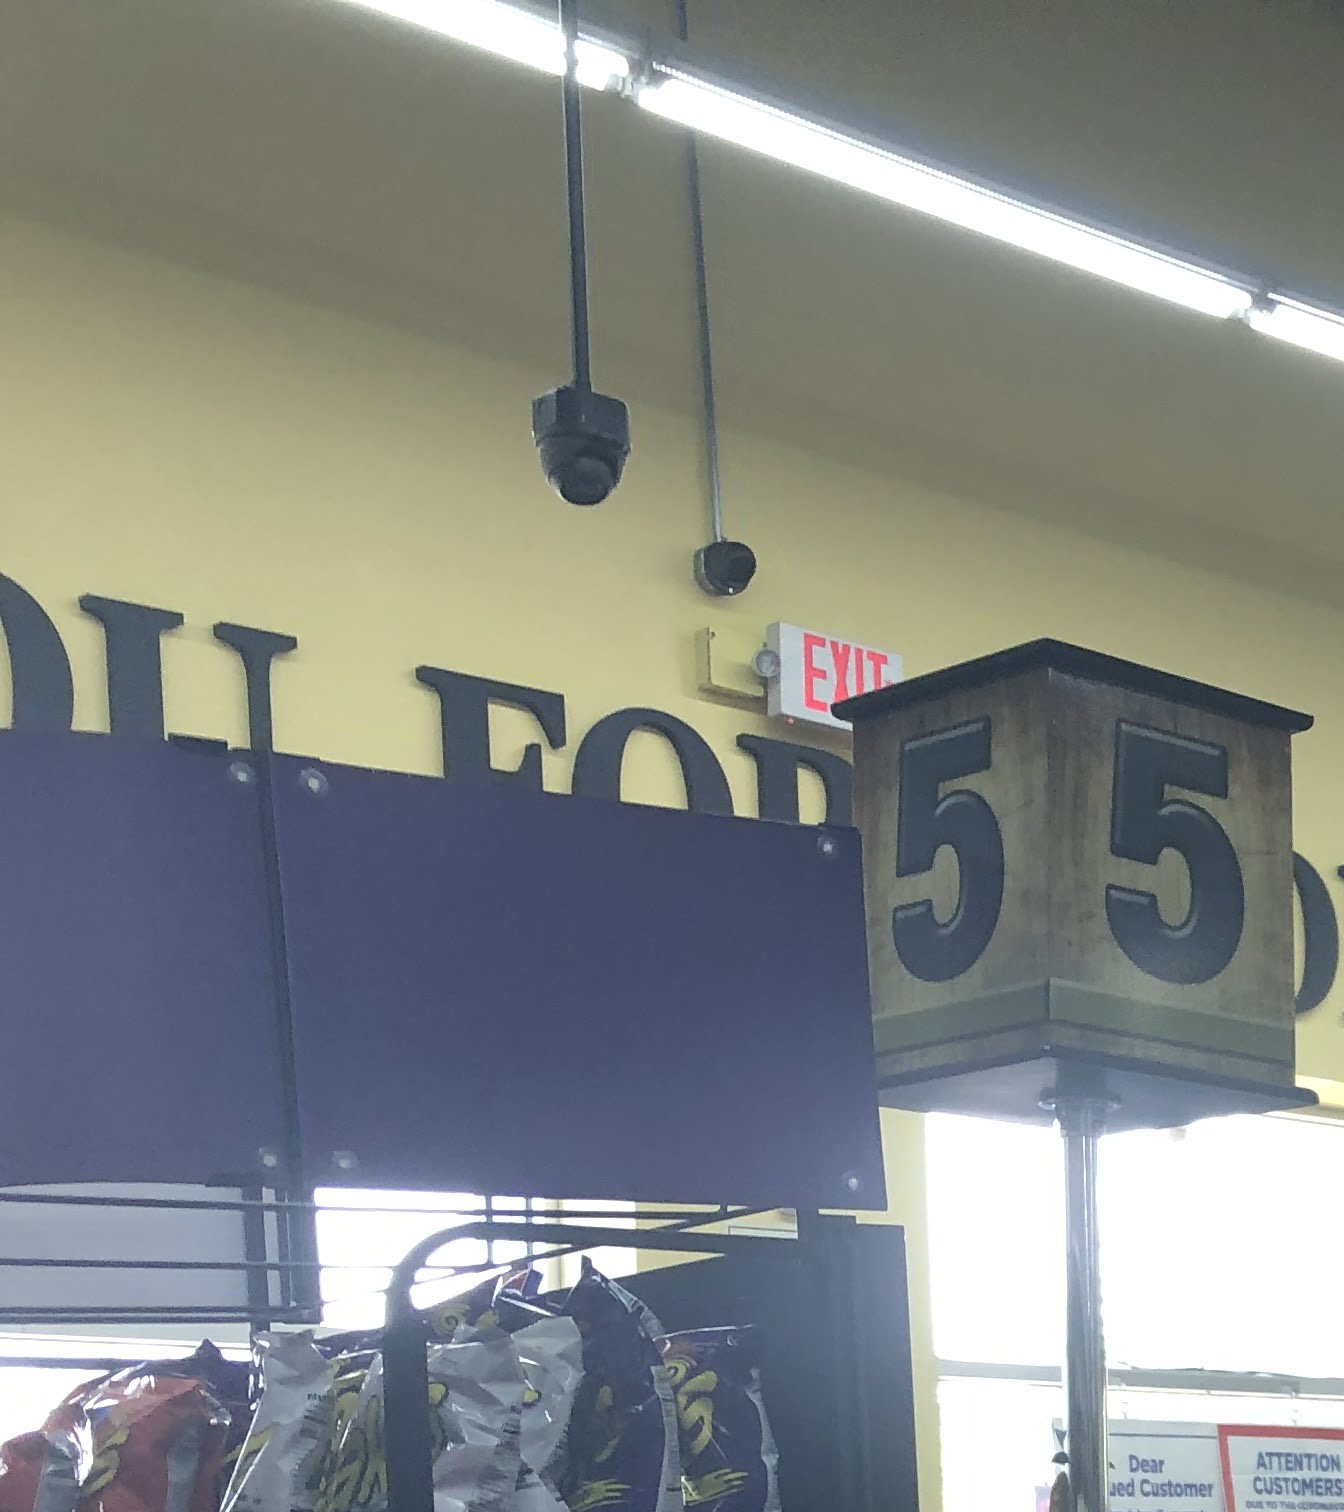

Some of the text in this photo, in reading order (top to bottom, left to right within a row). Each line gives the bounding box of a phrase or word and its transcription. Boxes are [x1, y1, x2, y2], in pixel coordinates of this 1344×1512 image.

[892, 716, 1006, 984] 5
[1104, 718, 1246, 986] 5
[1129, 1453, 1165, 1473] Dear
[1256, 1451, 1341, 1472] ATTENTION
[1140, 1478, 1213, 1498] Customer
